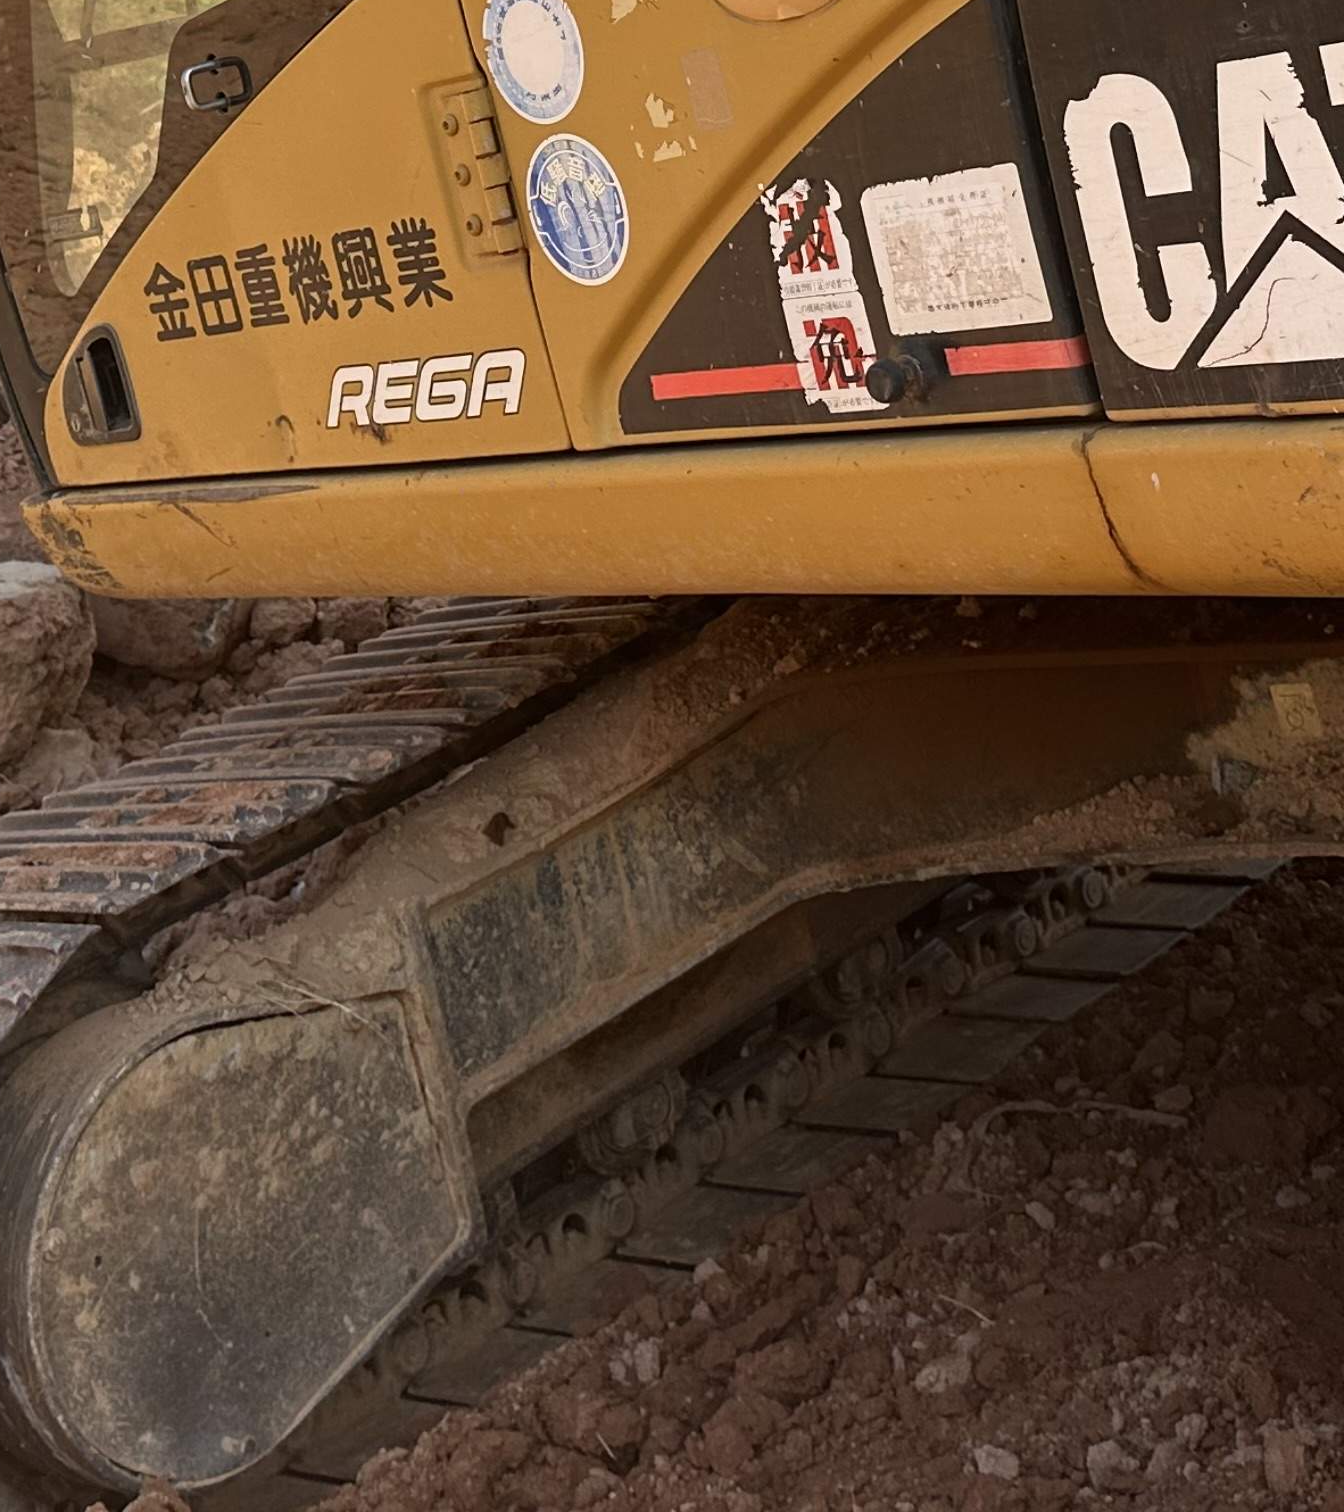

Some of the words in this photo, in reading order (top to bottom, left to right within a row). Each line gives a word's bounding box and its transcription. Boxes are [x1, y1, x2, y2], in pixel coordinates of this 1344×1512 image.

[143, 217, 453, 342] 金田重機興業
[325, 348, 527, 429] REGA
